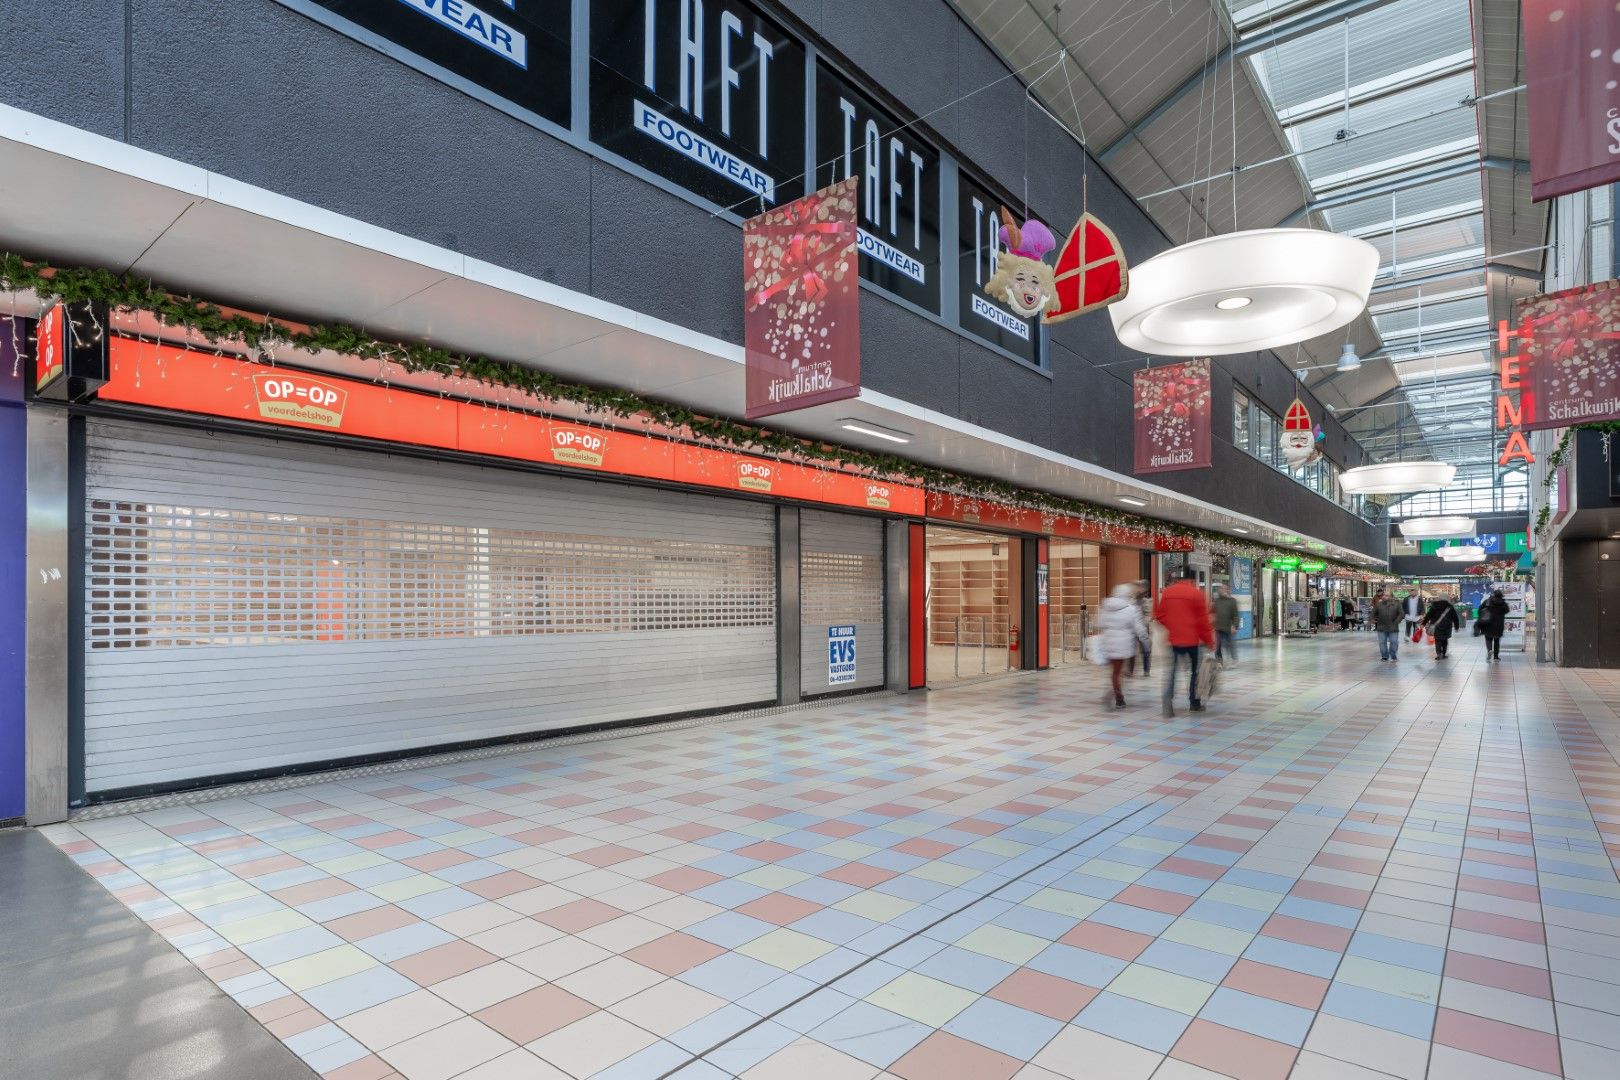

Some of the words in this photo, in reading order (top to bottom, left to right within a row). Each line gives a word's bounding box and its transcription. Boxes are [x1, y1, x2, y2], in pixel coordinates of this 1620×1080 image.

[643, 109, 767, 194] FOOTWEAR
[840, 97, 923, 250] TAFT
[857, 232, 921, 278] OOTWEAR
[975, 299, 1027, 336] FOOTWEAR
[264, 380, 338, 406] OP=OP
[1497, 317, 1535, 465] HEMA
[267, 405, 333, 423] voordeelshop
[1549, 397, 1620, 420] Schalkwijk
[556, 431, 601, 450] OP=OP
[740, 463, 771, 478] OP=OP
[830, 639, 855, 663] EVS
